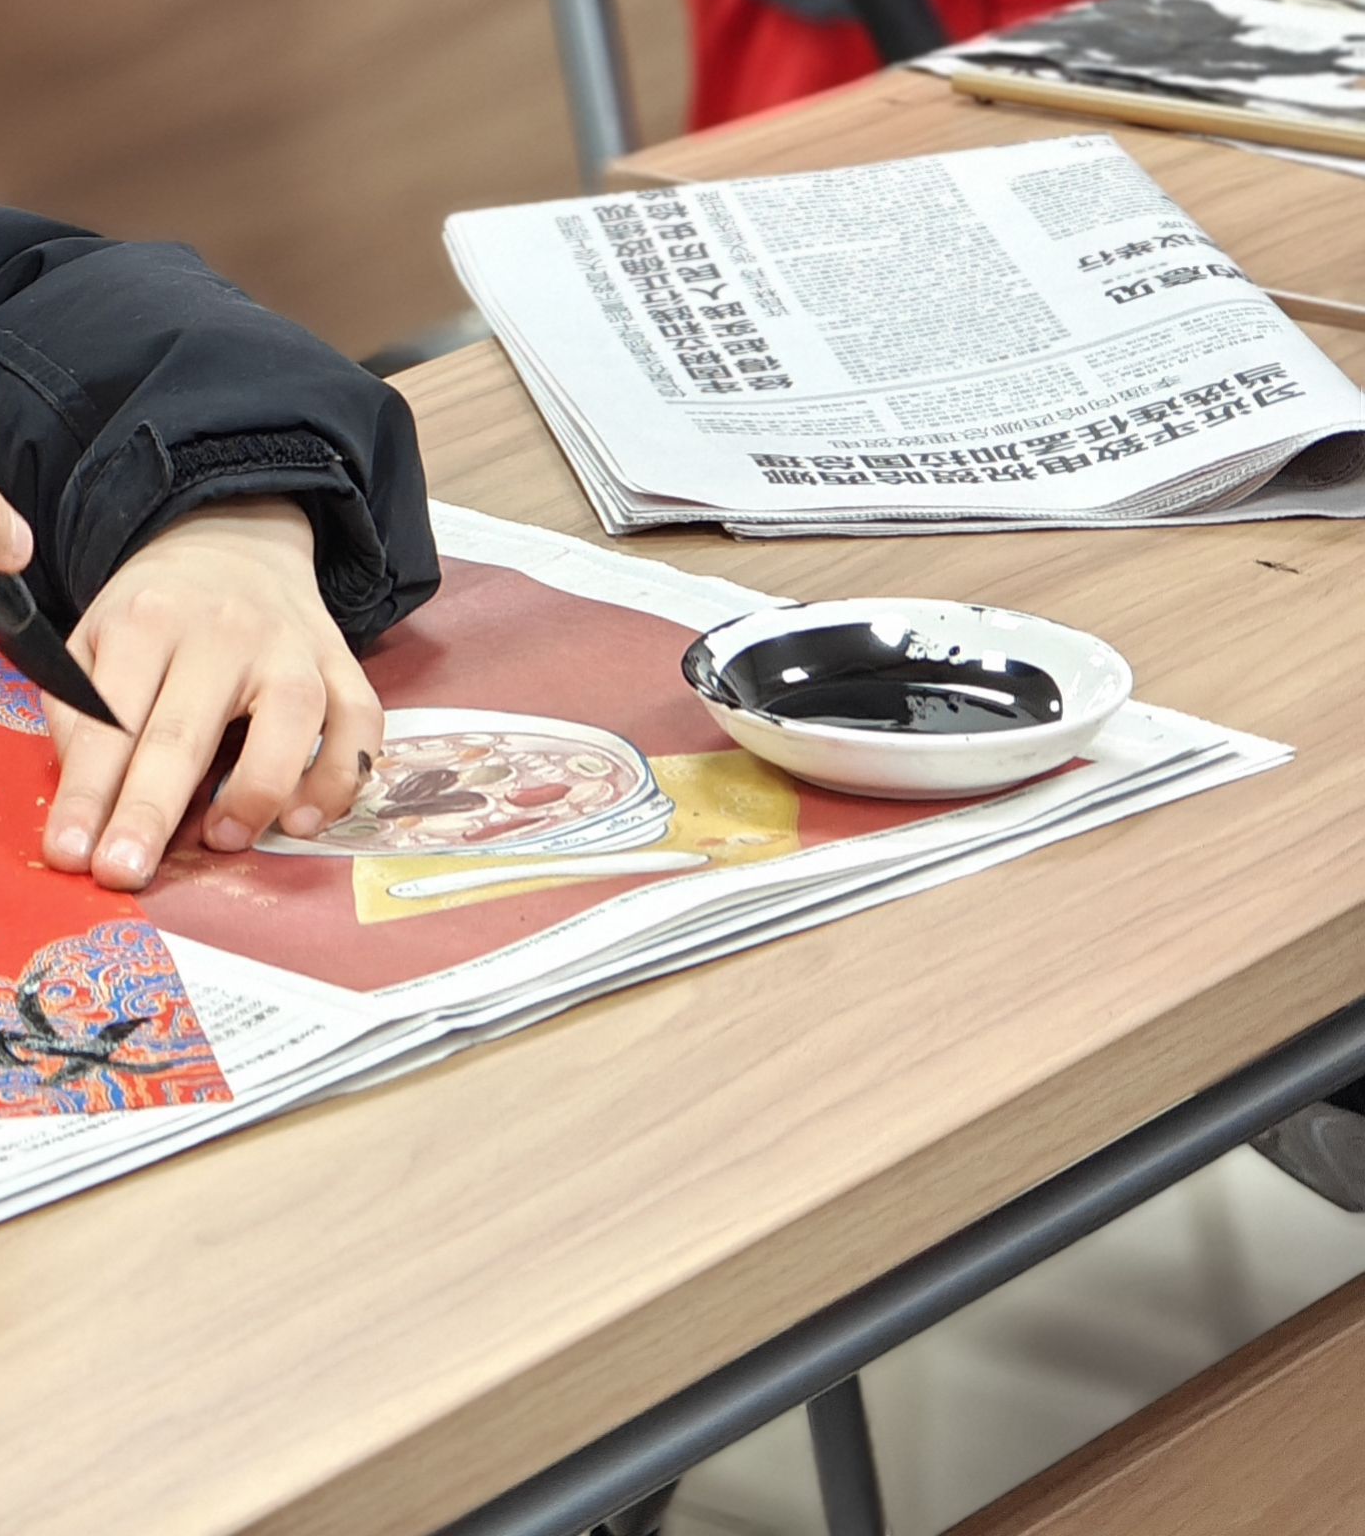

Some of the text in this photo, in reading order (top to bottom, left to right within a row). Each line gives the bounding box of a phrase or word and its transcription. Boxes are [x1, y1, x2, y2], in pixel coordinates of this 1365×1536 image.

[592, 203, 744, 394] 牢固树立和践行正确政绩观
[747, 362, 1289, 469] 当选连任孟加拉国总理
[762, 381, 1307, 485] 习近平致电祝贺哈西娜
